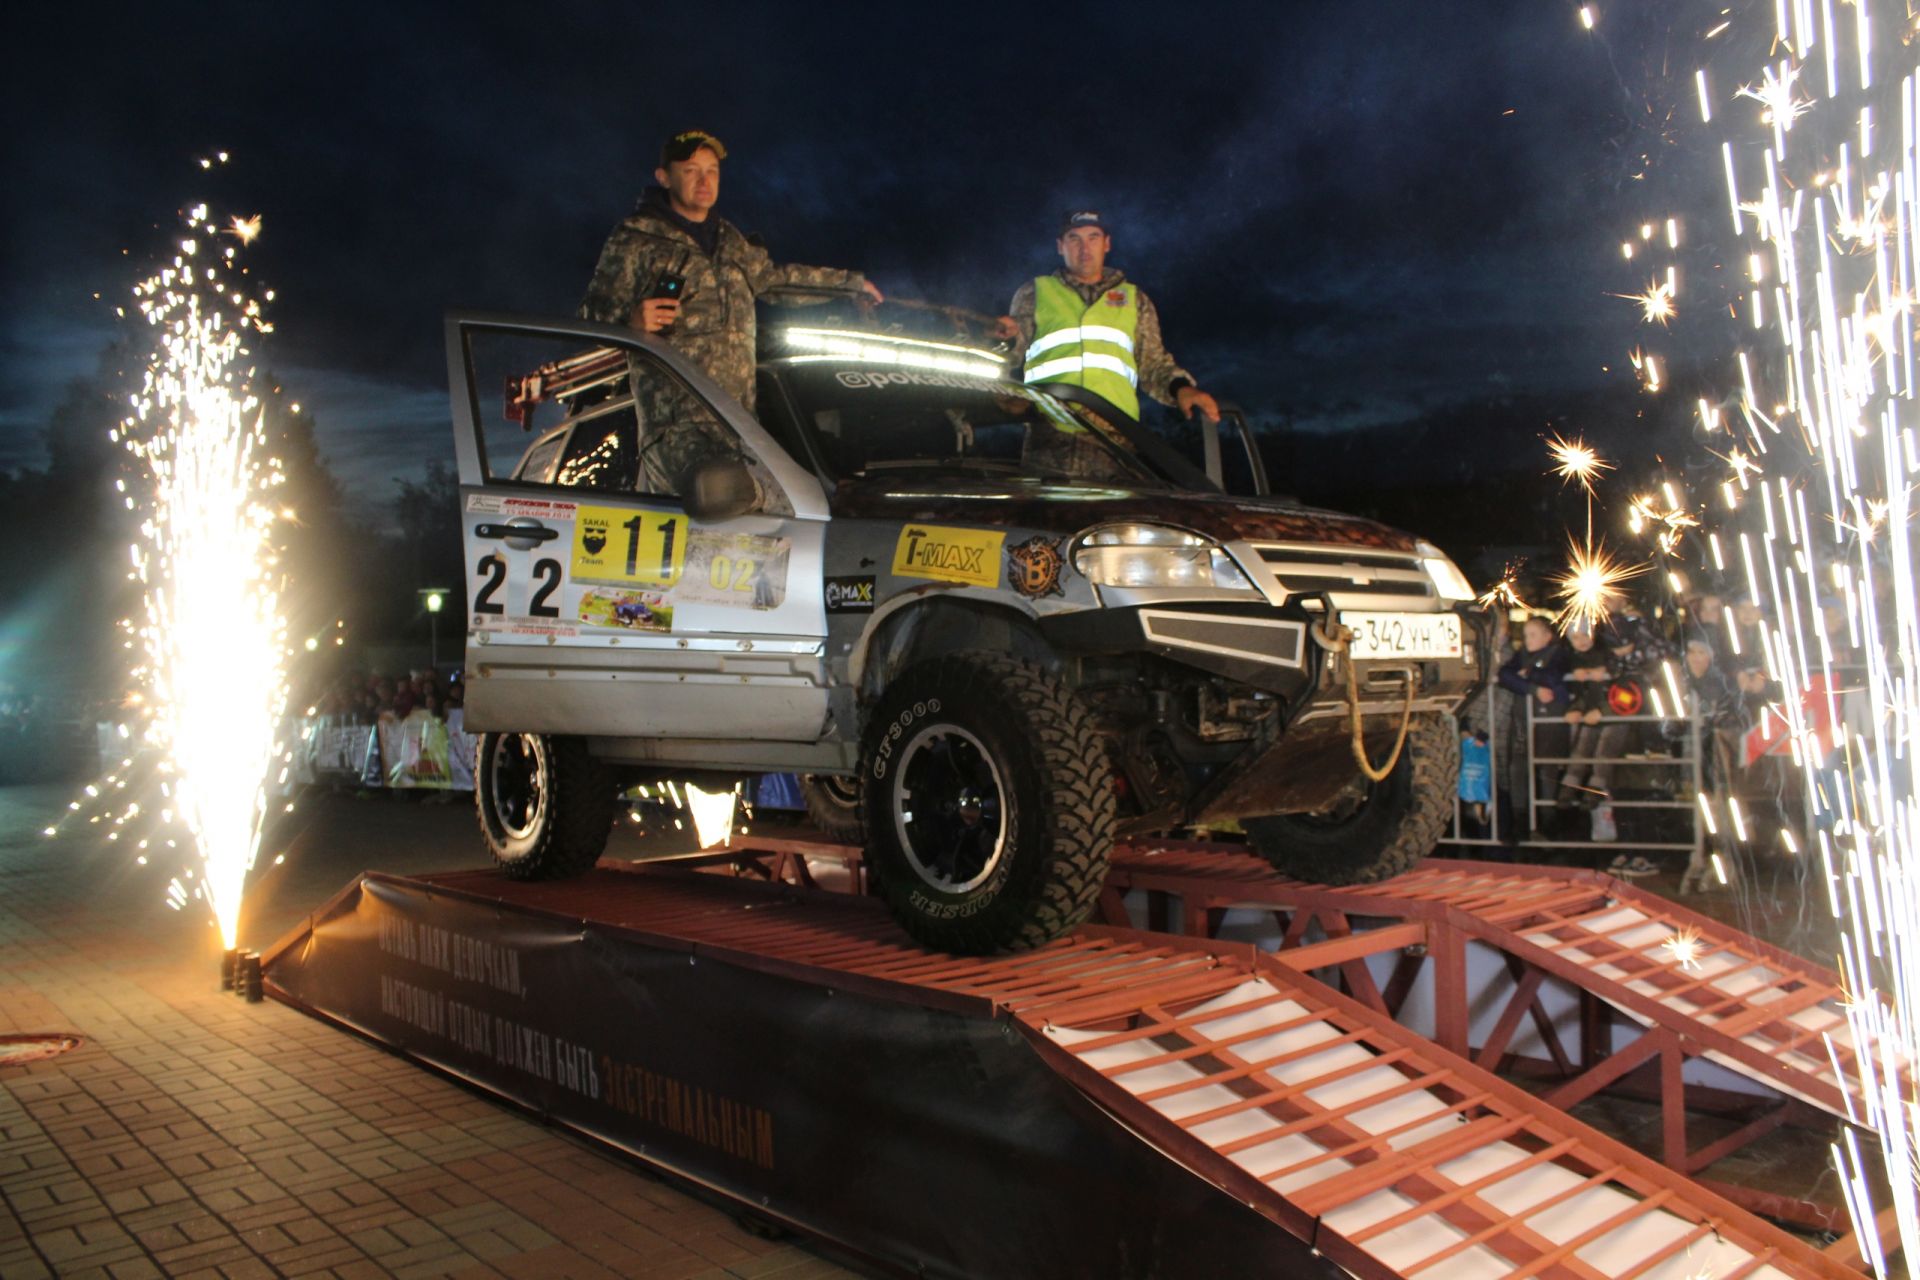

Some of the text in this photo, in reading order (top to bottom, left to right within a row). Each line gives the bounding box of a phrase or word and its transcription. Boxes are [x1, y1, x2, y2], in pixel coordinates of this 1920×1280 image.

[582, 517, 611, 528] SAKAL
[579, 555, 604, 567] Team
[905, 527, 985, 574] T-MAX
[708, 556, 755, 593] 02
[380, 974, 775, 1170] НАСТОЯЩИЙ ОТДЫХ ДОЛЖЕН БЫТЬ ЭКСТРЕМАЛЬНЫМ
